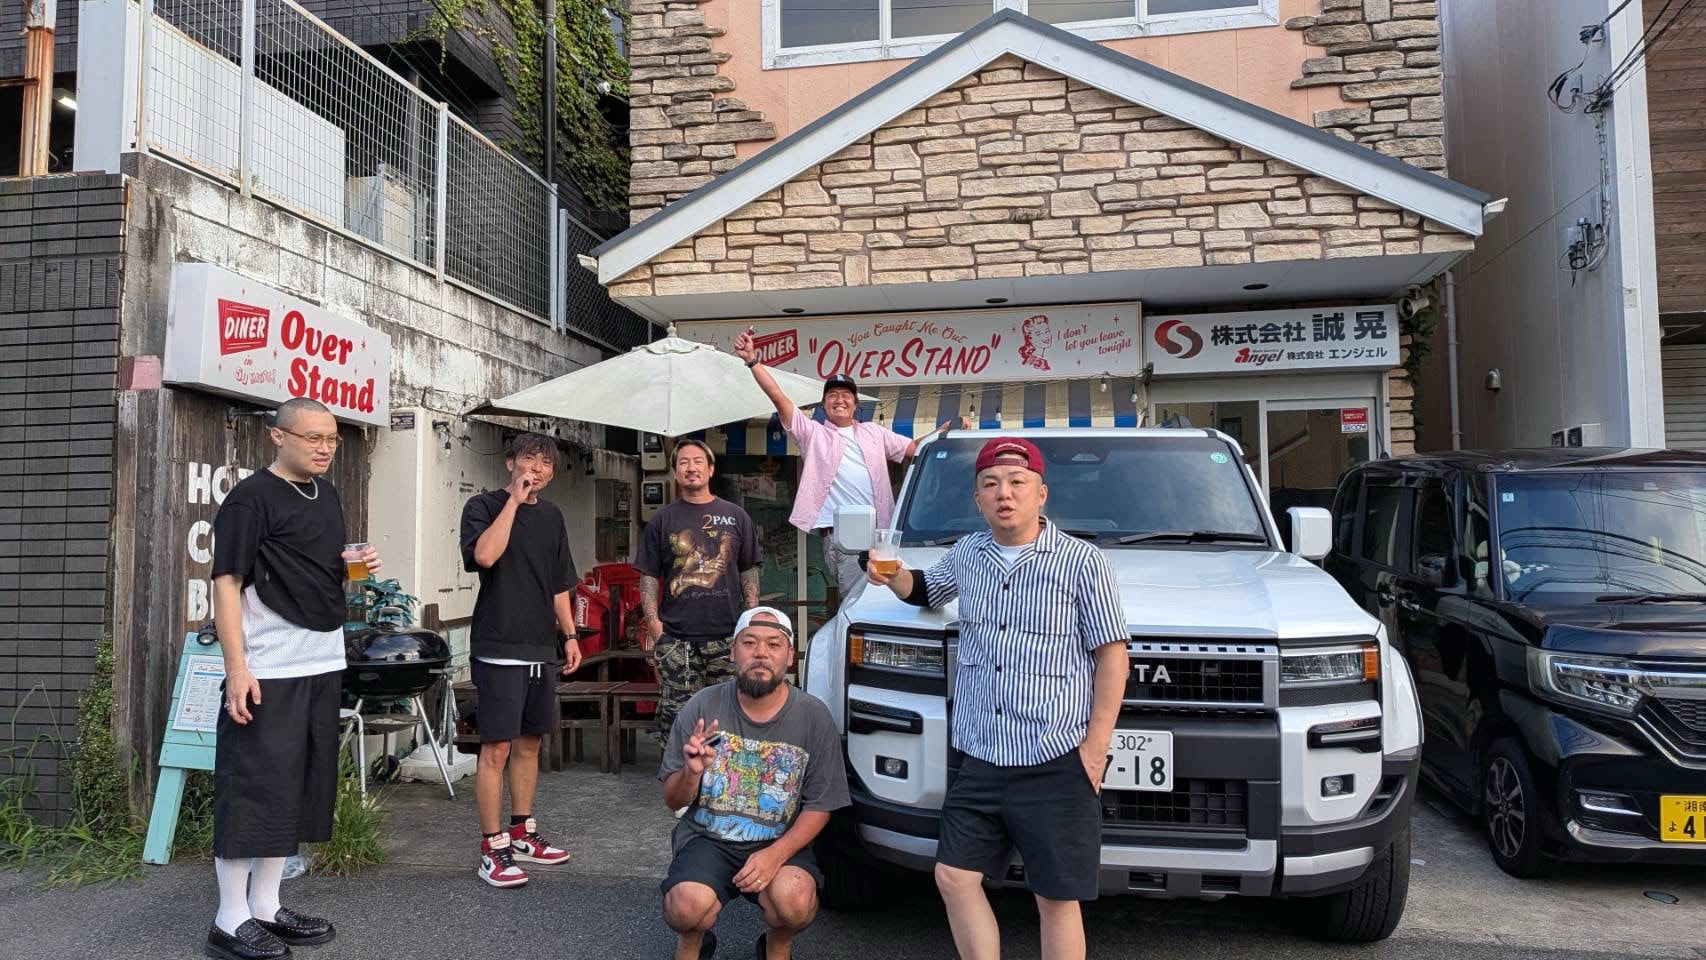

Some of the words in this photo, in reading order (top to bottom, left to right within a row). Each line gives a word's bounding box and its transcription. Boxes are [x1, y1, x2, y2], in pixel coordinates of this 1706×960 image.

[224, 315, 265, 340] DINER
[848, 331, 870, 347] You
[874, 319, 917, 336] Caught
[941, 326, 968, 344] Out
[1063, 324, 1087, 340] don't
[280, 310, 353, 365] Over
[1065, 341, 1078, 352] let
[1079, 337, 1097, 351] you
[1099, 330, 1125, 342] leave
[1098, 338, 1133, 355] tonight
[754, 336, 795, 362] DINER
[1286, 350, 1324, 360] 株式会社
[1328, 347, 1388, 359] エンジェル
[287, 357, 375, 414] Stand
[701, 514, 736, 529] 2PAC
[1133, 664, 1172, 683] TA
[1116, 735, 1147, 751] 302
[1668, 820, 1677, 832] よ
